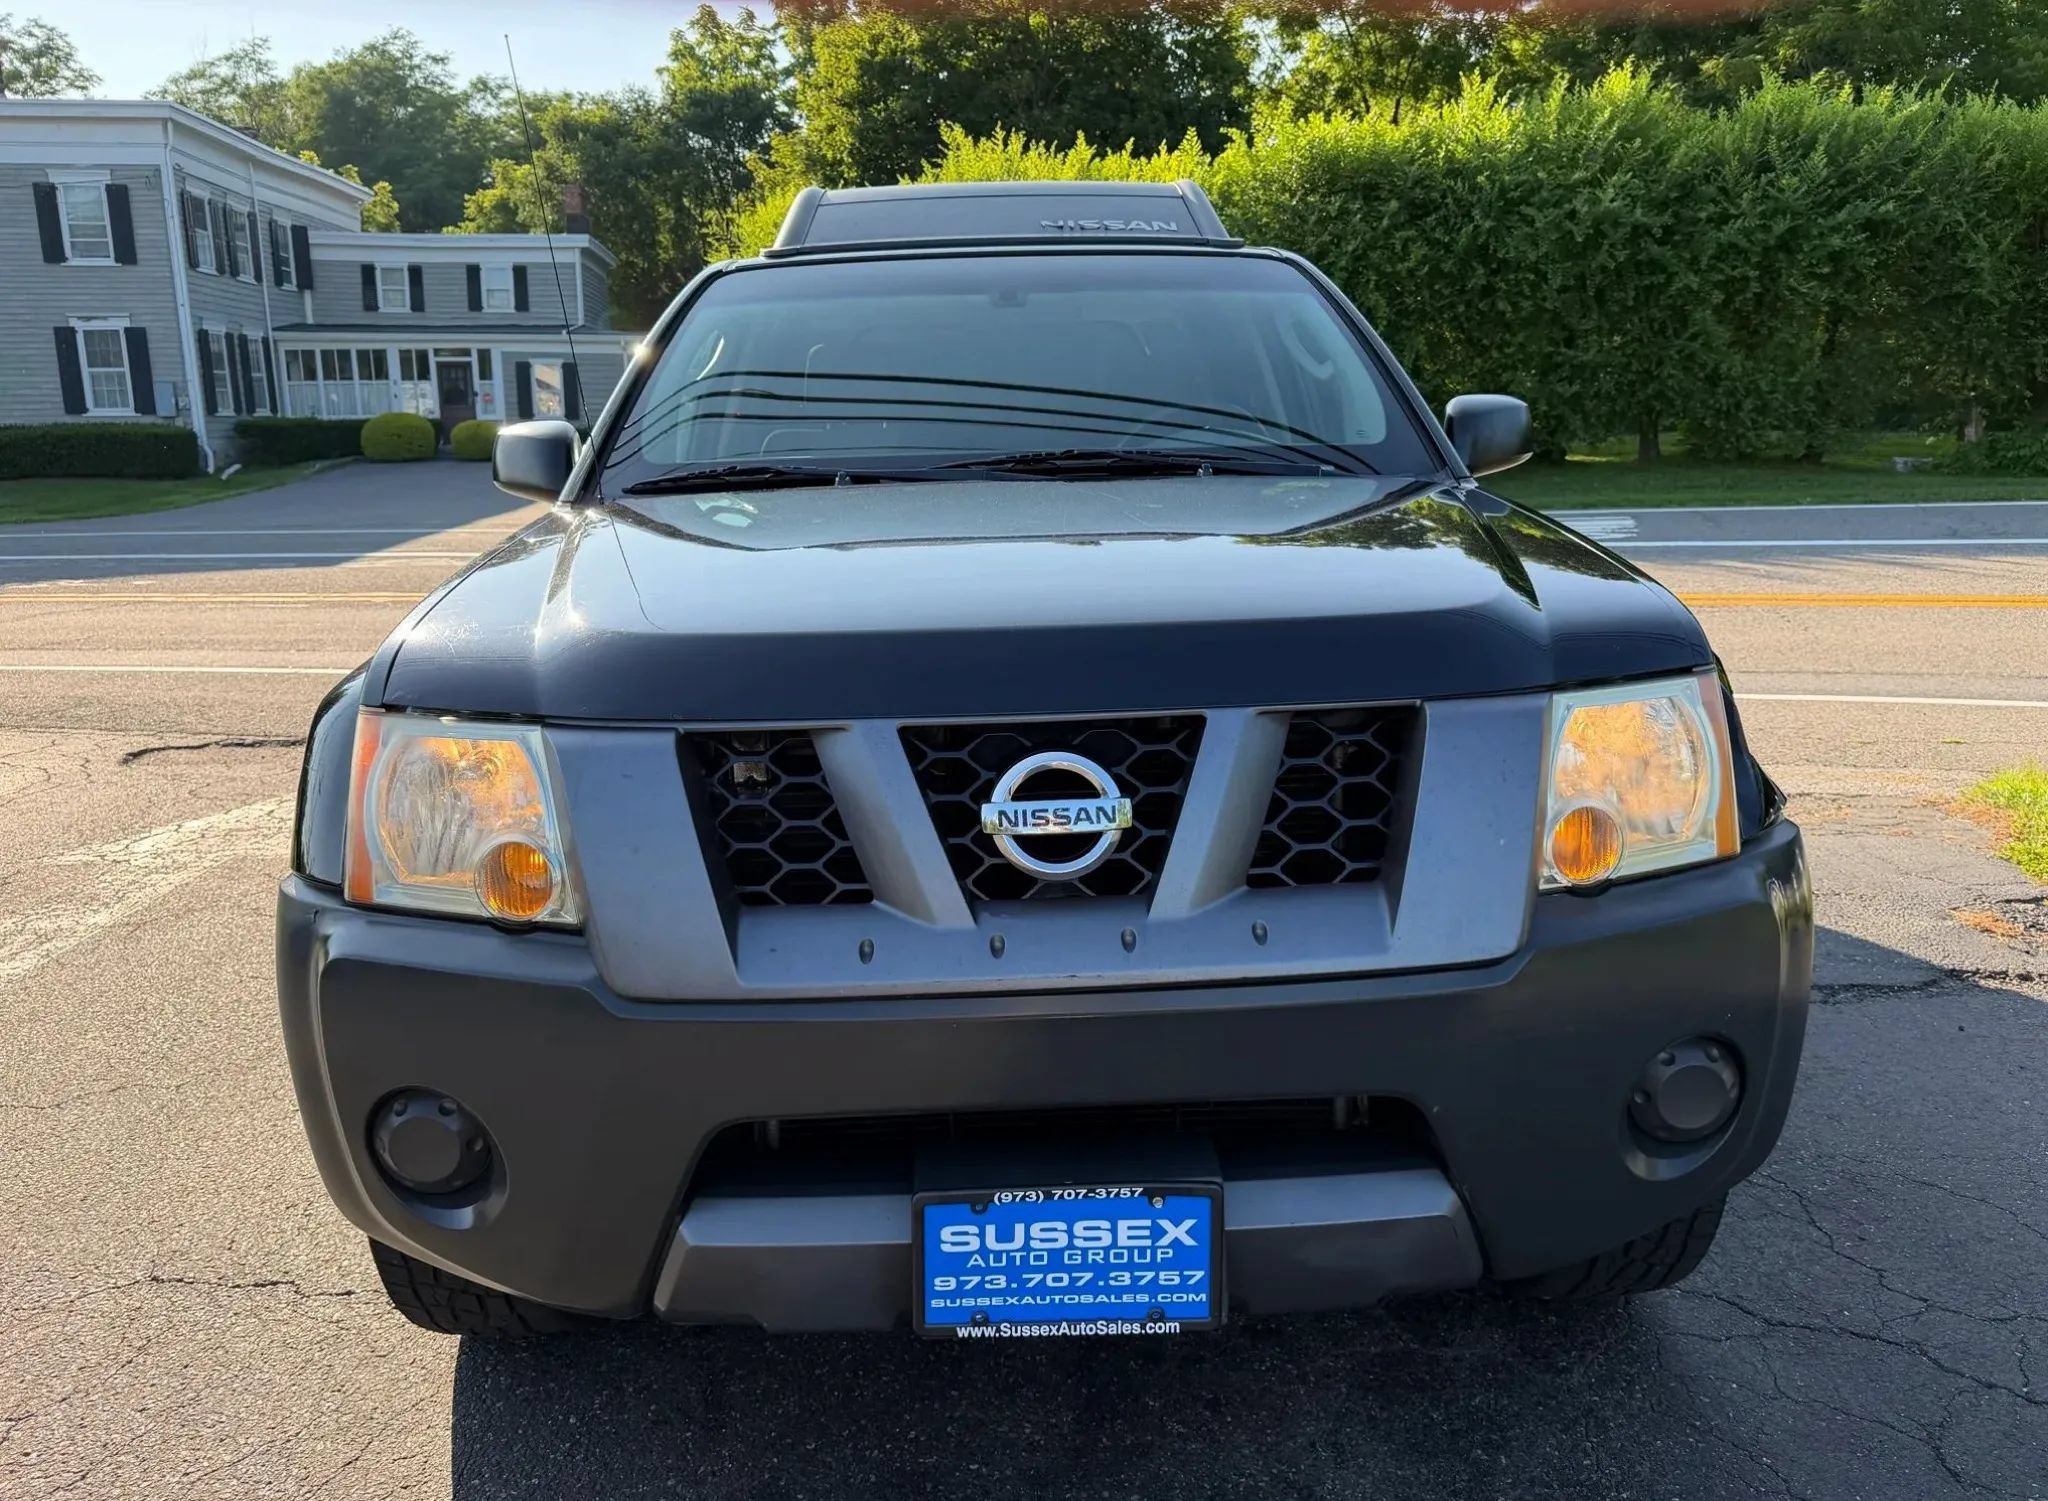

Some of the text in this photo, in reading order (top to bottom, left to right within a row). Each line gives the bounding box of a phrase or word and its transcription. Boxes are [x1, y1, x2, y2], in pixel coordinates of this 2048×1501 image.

[1040, 219, 1178, 231] NISSAN
[997, 805, 1117, 828] NISSAN
[993, 1187, 1144, 1206] (973) 707-3757
[939, 1218, 1198, 1253] SUSSEX
[966, 1248, 1174, 1268] AUTO GROUP
[933, 1271, 1205, 1291] 973.707.3757
[930, 1293, 1207, 1308] SUSSEXAUTOSALES.COM
[956, 1320, 1181, 1339] www.SussexAutoSales.com
